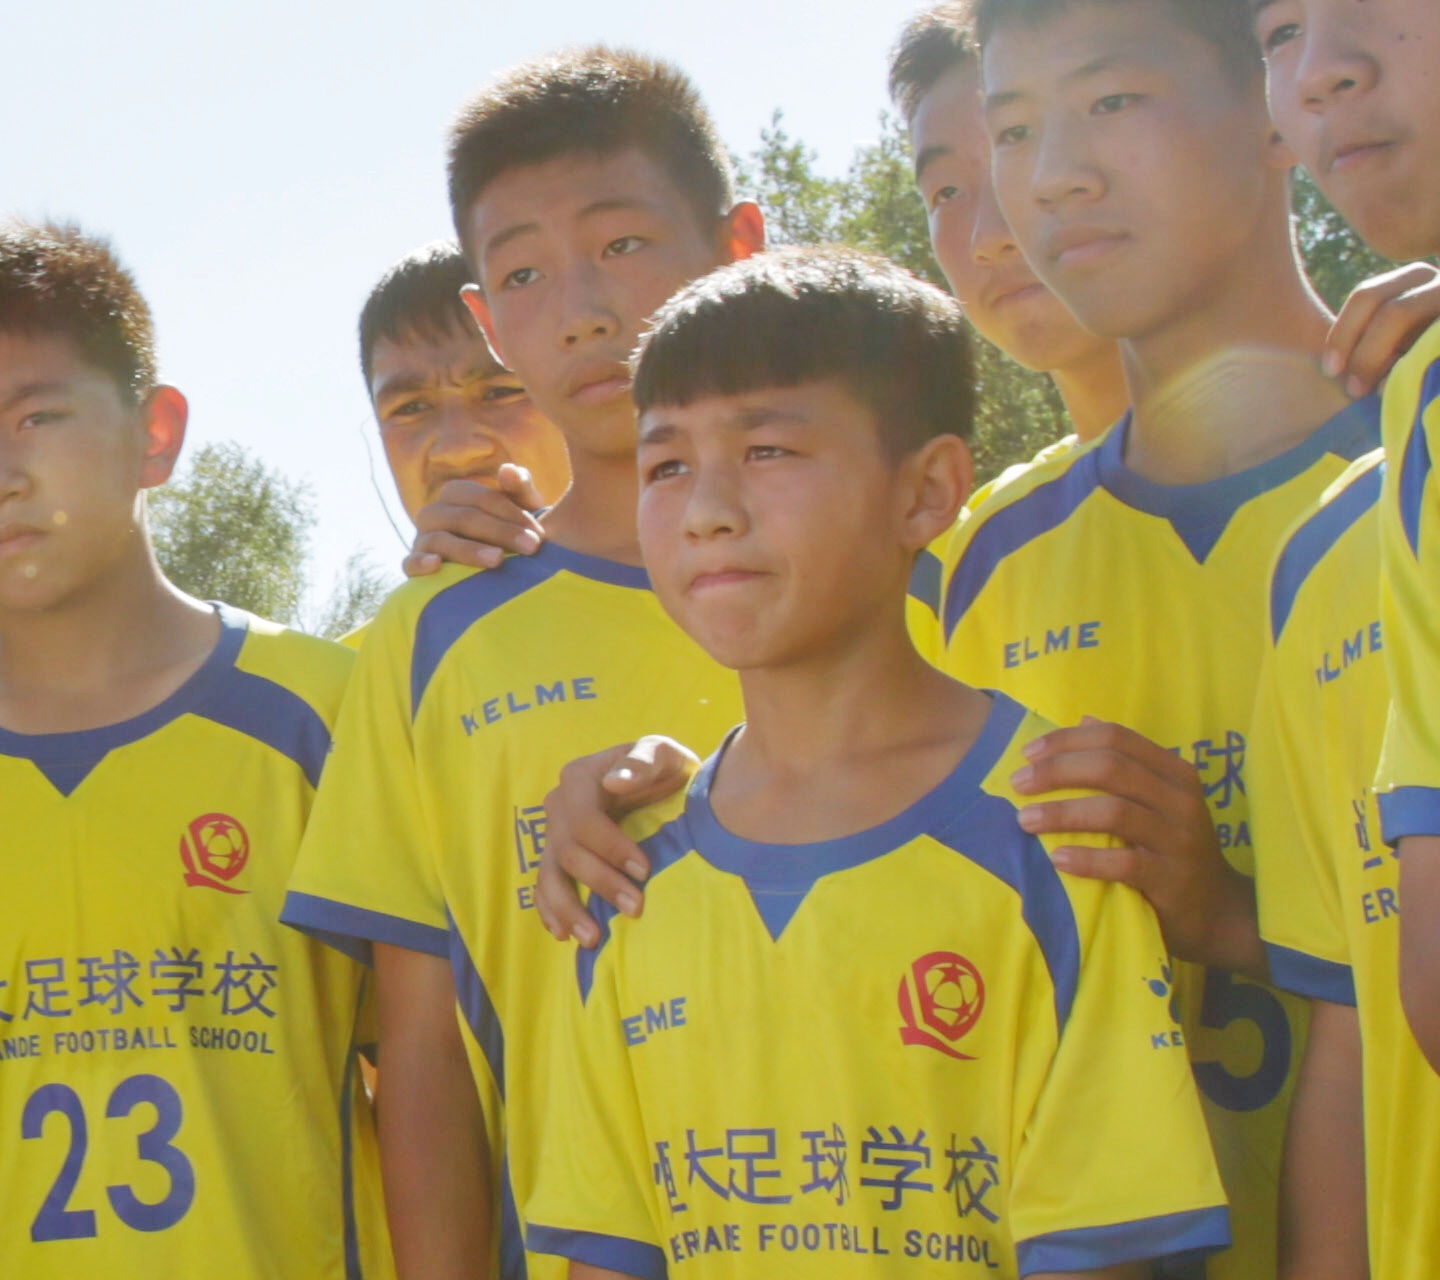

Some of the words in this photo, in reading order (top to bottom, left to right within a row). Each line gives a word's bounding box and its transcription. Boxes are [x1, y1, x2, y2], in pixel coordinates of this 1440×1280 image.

[1004, 620, 1102, 669] ELME
[460, 677, 597, 737] KELME
[54, 1026, 177, 1055] FOOTBALL
[189, 1025, 276, 1054] SCHOOL
[21, 1073, 196, 1243] 23
